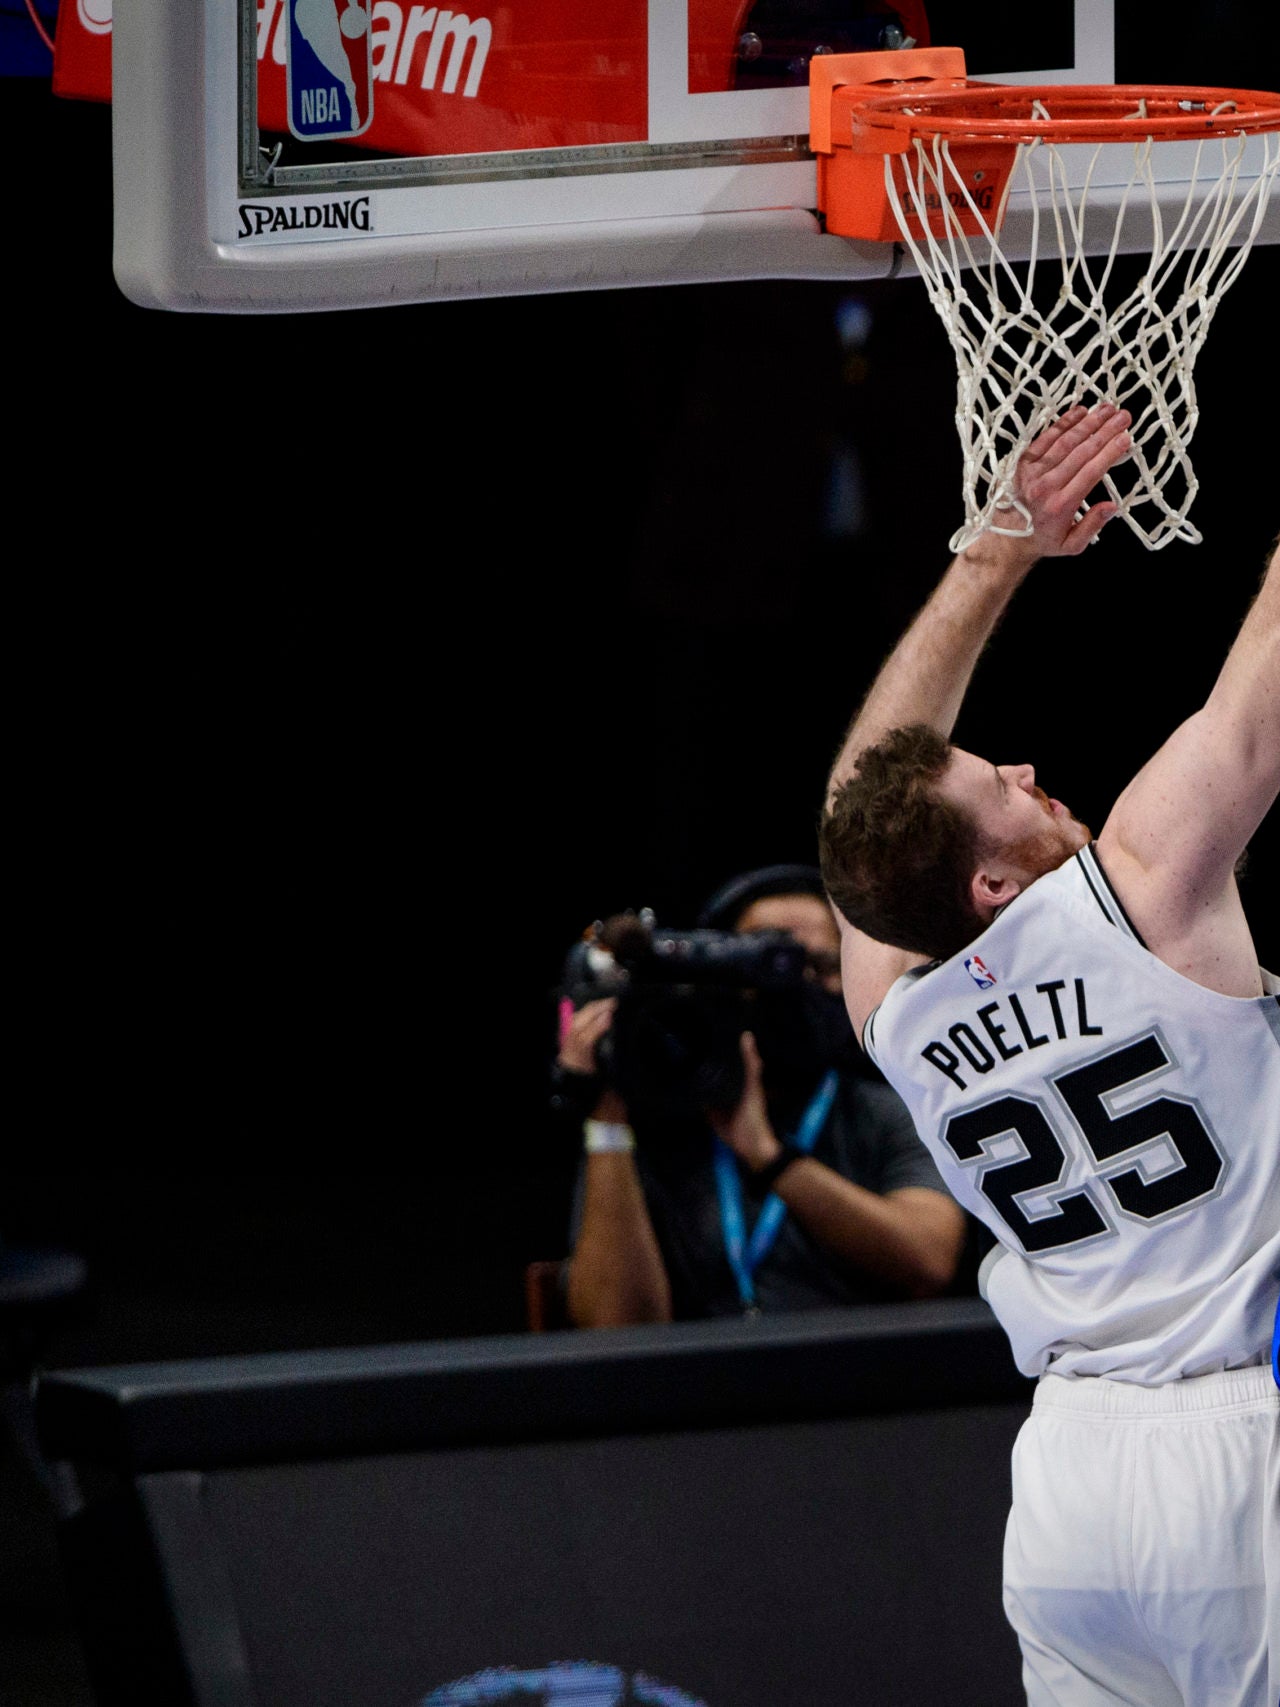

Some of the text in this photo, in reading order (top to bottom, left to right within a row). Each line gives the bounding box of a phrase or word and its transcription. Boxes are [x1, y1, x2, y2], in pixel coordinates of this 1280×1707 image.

[371, 0, 492, 98] arm
[301, 87, 342, 125] NBA
[238, 196, 371, 239] SPALDING
[921, 978, 1103, 1091] POELTL
[938, 1024, 1232, 1259] 25
